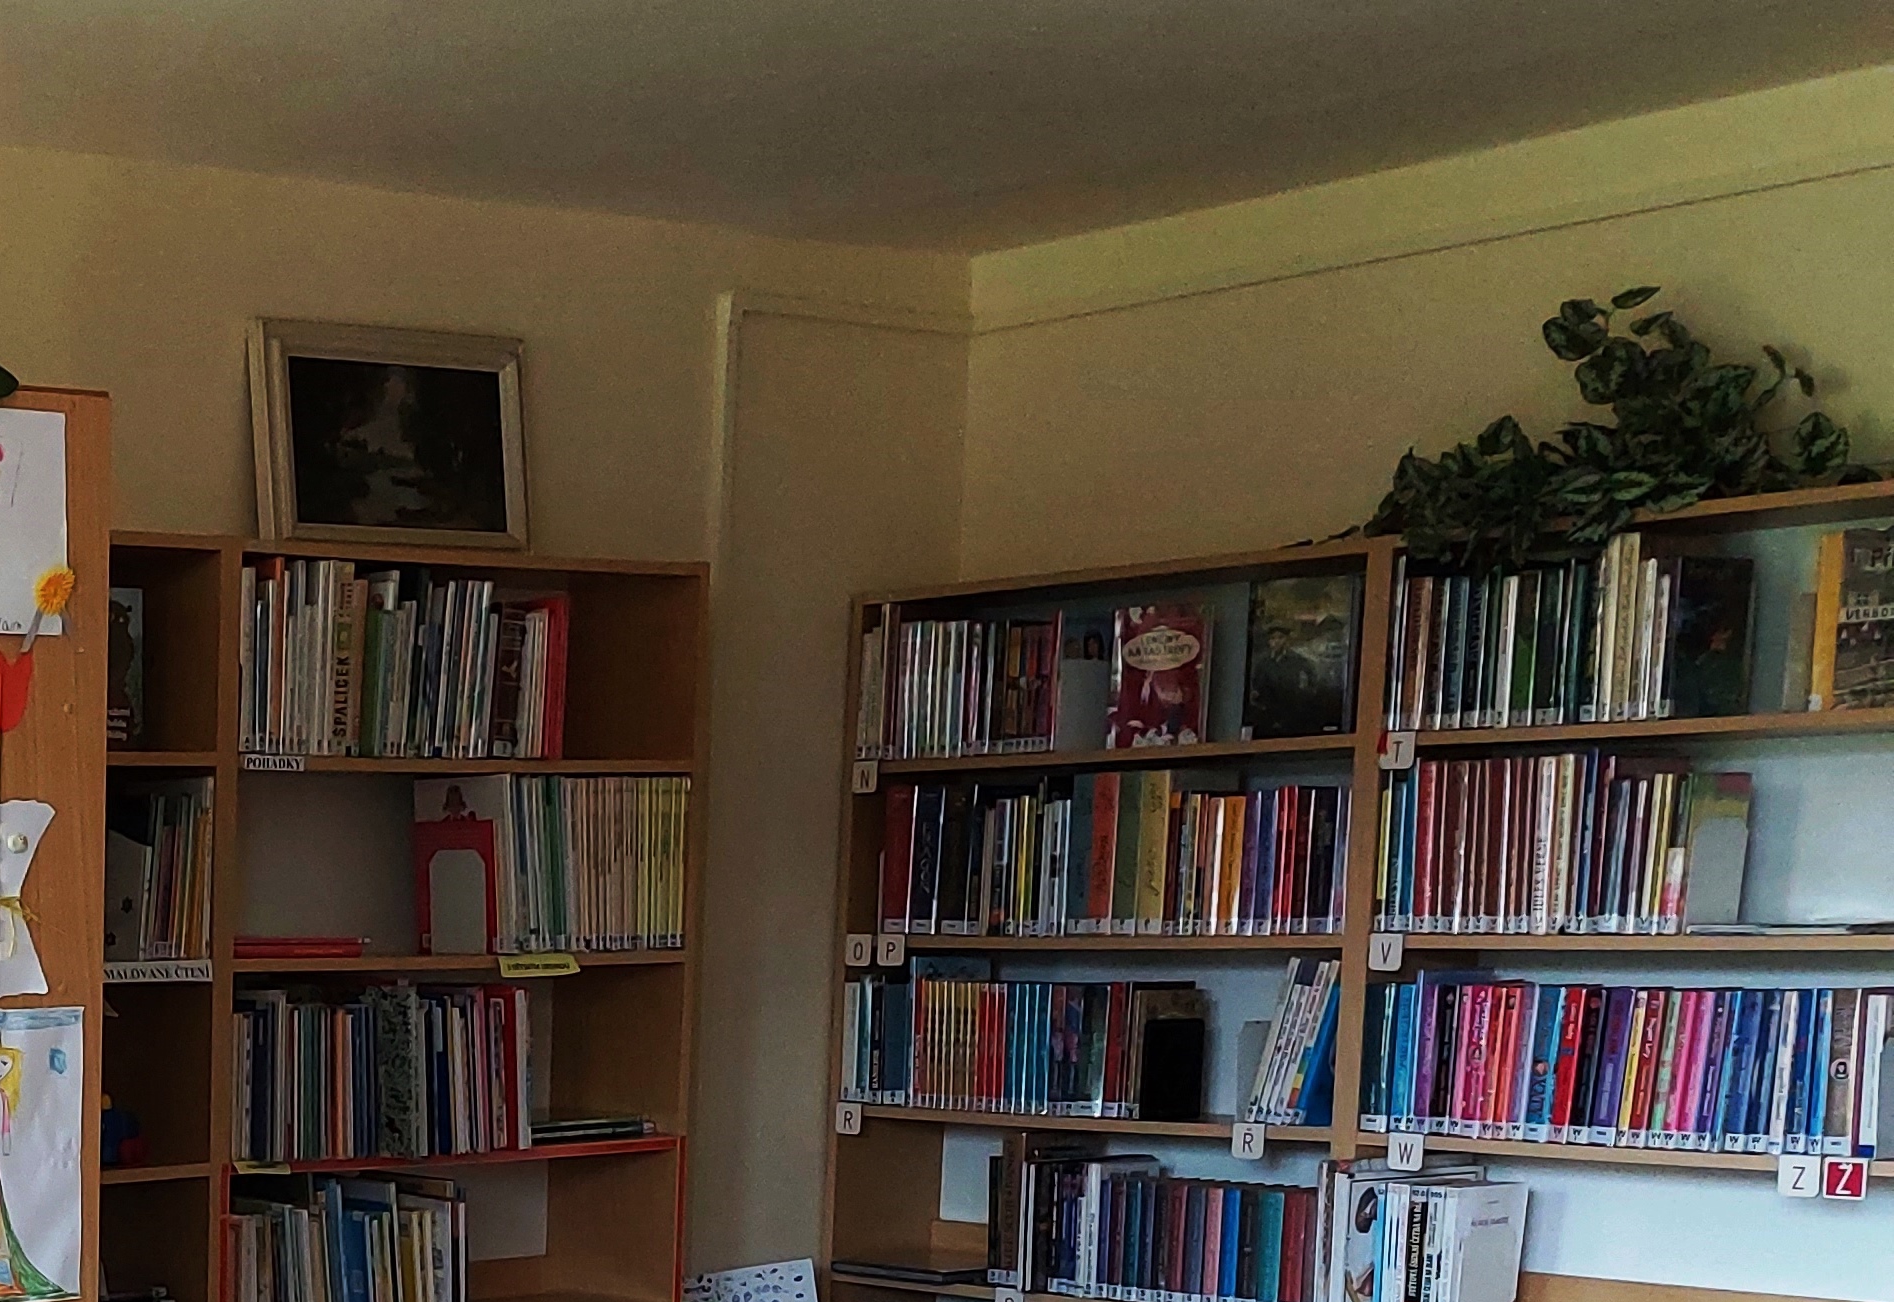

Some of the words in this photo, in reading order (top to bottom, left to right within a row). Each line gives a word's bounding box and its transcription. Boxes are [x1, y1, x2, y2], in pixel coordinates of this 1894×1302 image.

[1393, 742, 1404, 762] T
[858, 768, 871, 787] N
[886, 942, 896, 960] P
[1381, 944, 1392, 963] V
[844, 1113, 853, 1130] R
[1242, 1128, 1254, 1152] Ř
[1398, 1143, 1412, 1164] W
[1792, 1167, 1804, 1188] Z
[1837, 1162, 1853, 1194] Ž
